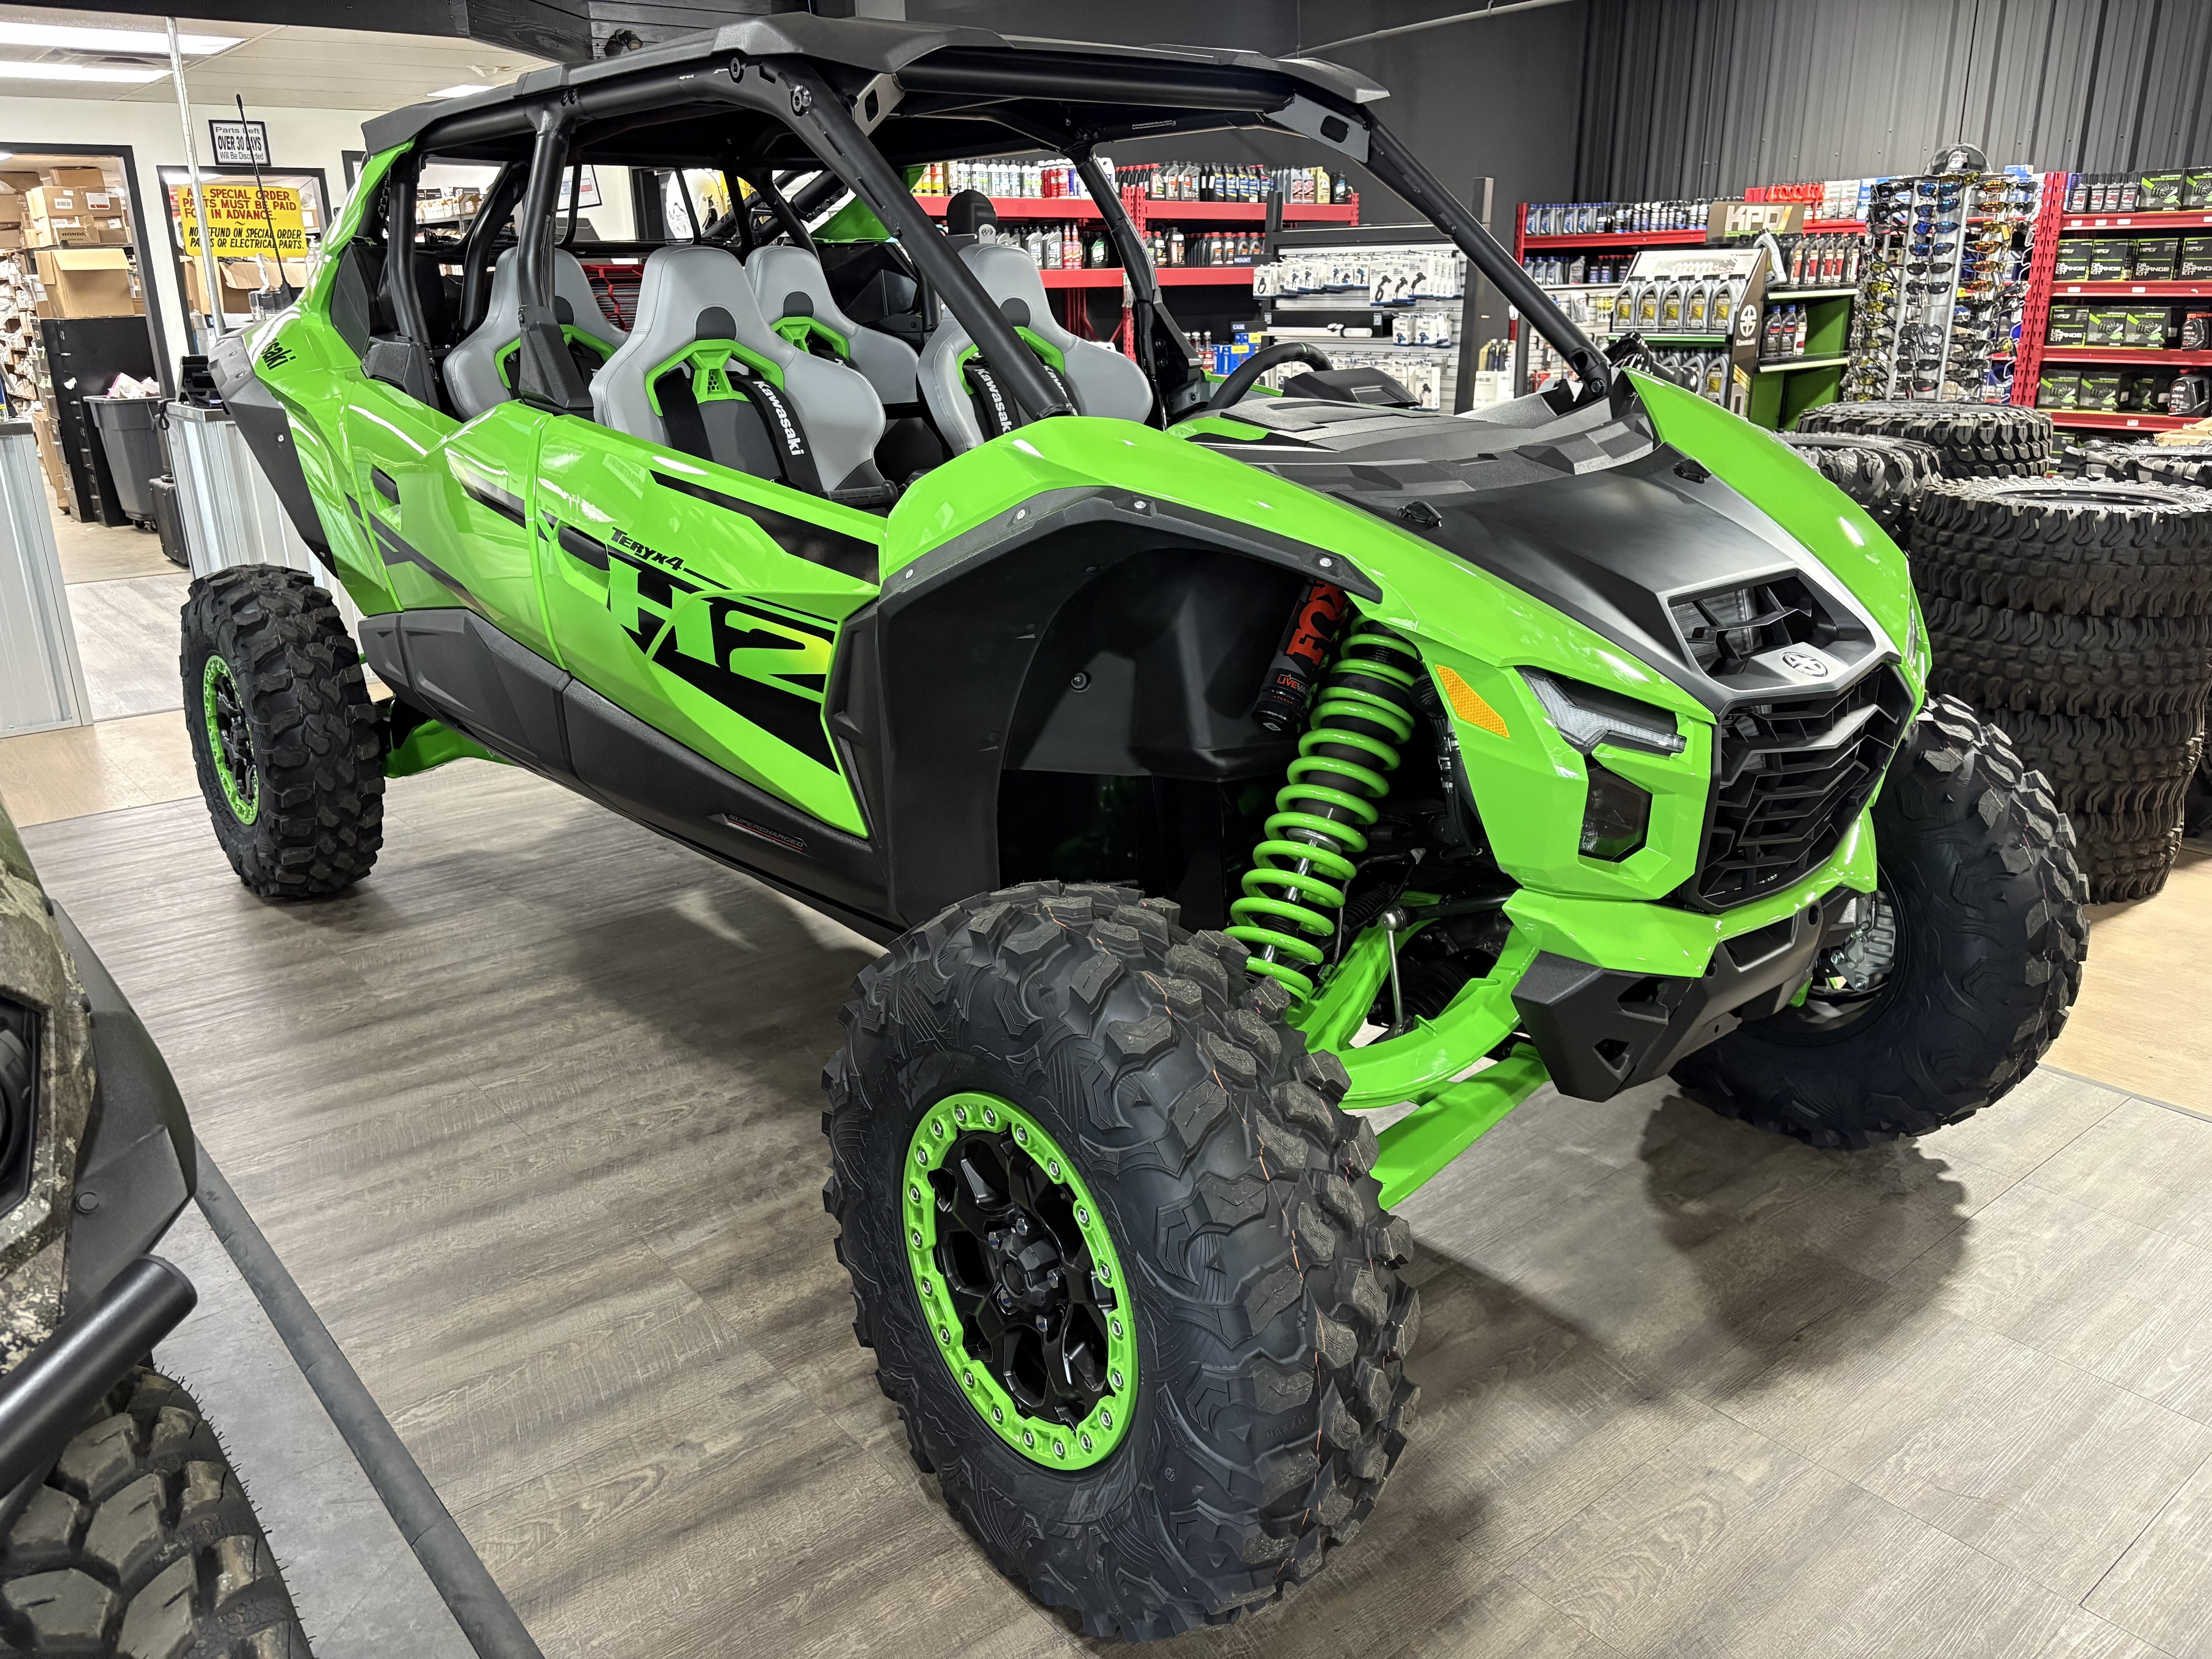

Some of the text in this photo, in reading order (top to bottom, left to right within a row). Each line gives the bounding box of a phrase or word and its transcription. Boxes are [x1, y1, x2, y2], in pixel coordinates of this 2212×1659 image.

[218, 136, 235, 150] OVER
[236, 136, 244, 150] 30
[239, 152, 263, 160] Discaded
[210, 188, 251, 199] SPECIAL
[255, 190, 290, 201] ORDER
[182, 198, 216, 208] PATS
[221, 199, 250, 208] MUST
[273, 201, 296, 210] PAID
[211, 209, 222, 218] IN
[227, 209, 276, 220] ADVANCE.
[189, 227, 199, 237] NO
[208, 227, 230, 237] FUND
[234, 228, 243, 237] ON
[277, 229, 301, 239] ORDER
[190, 237, 214, 247] PAS
[217, 238, 227, 247] OR
[279, 240, 304, 249] PARTS.
[974, 368, 1012, 434] Kawasak
[752, 381, 805, 455] Kawasaki
[1286, 580, 1348, 666] FOX
[609, 557, 833, 704] H2
[728, 814, 804, 848] SUPERCHARGED
